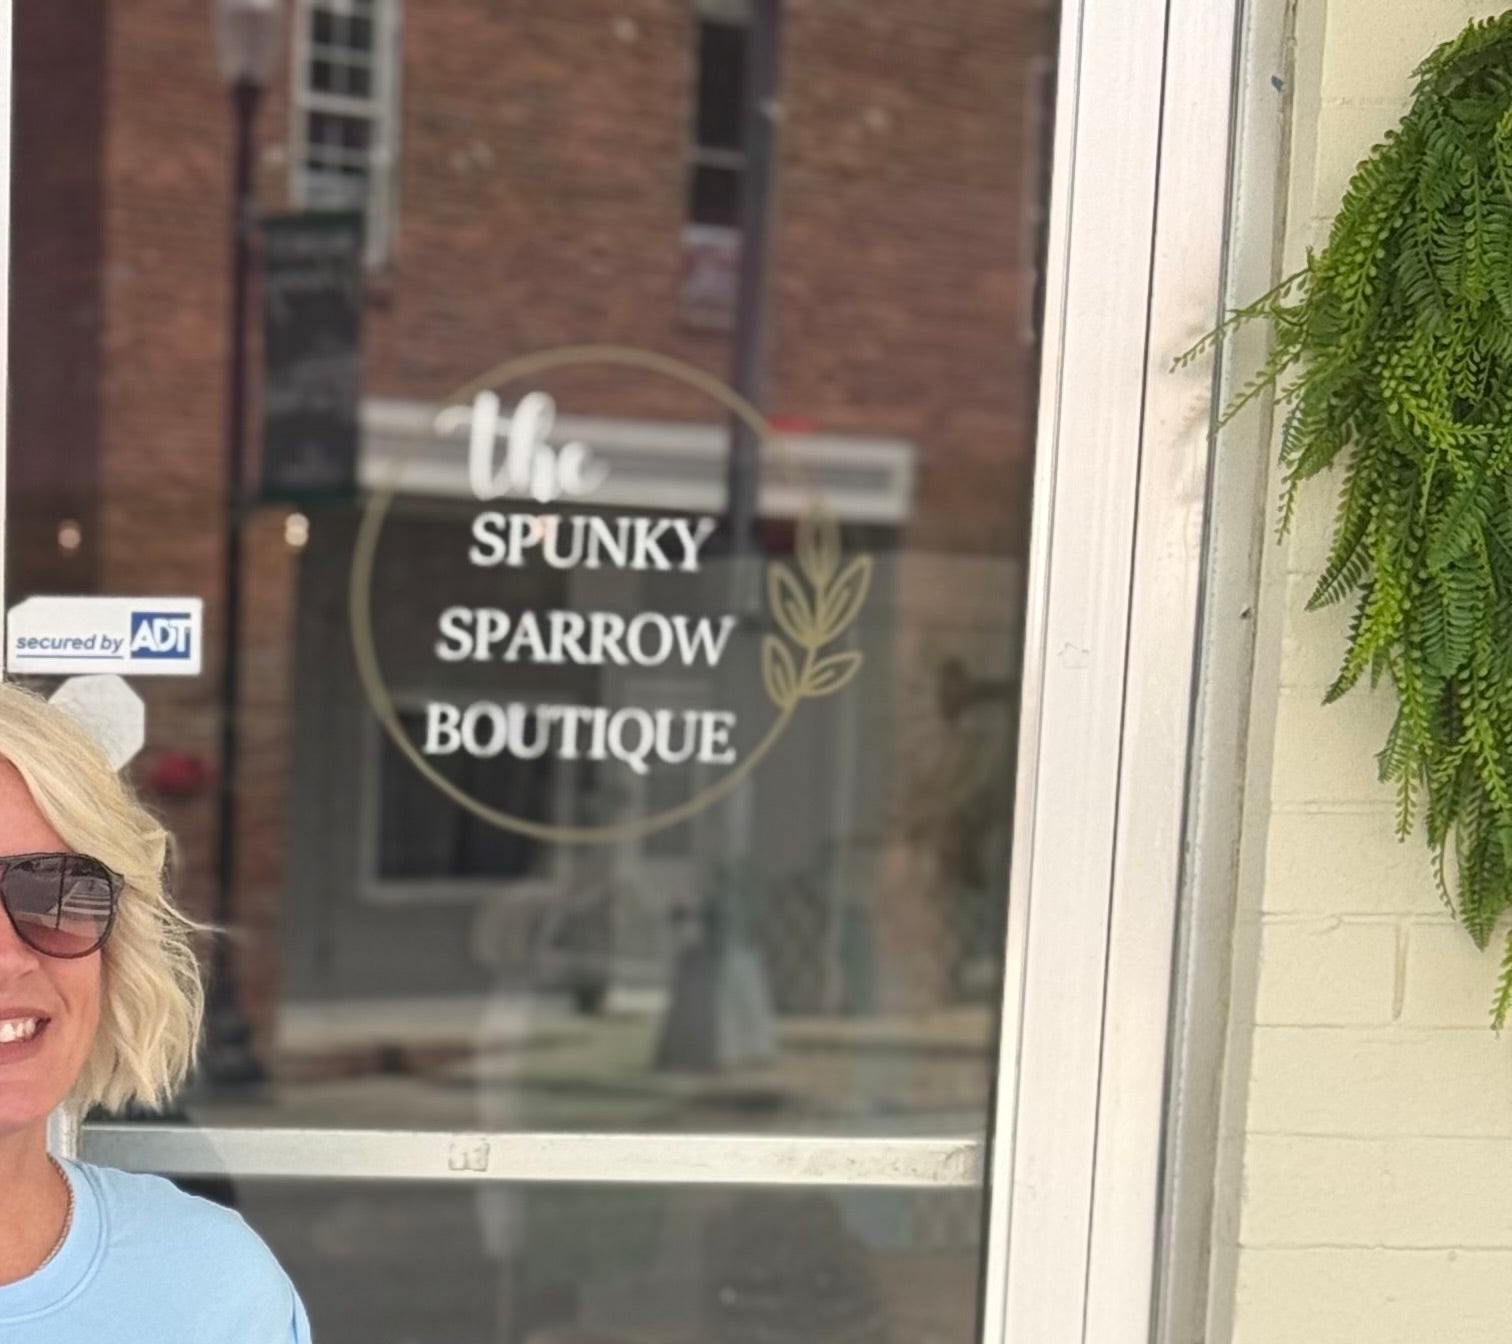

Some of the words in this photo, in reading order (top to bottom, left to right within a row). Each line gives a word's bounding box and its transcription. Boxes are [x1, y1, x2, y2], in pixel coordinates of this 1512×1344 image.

[434, 390, 610, 502] the
[469, 511, 717, 572] SPUNKY
[16, 634, 97, 651] secured
[100, 635, 124, 654] by
[130, 616, 192, 653] ADT
[434, 606, 737, 668] SPARROW
[423, 702, 737, 775] BOUTIQUE
